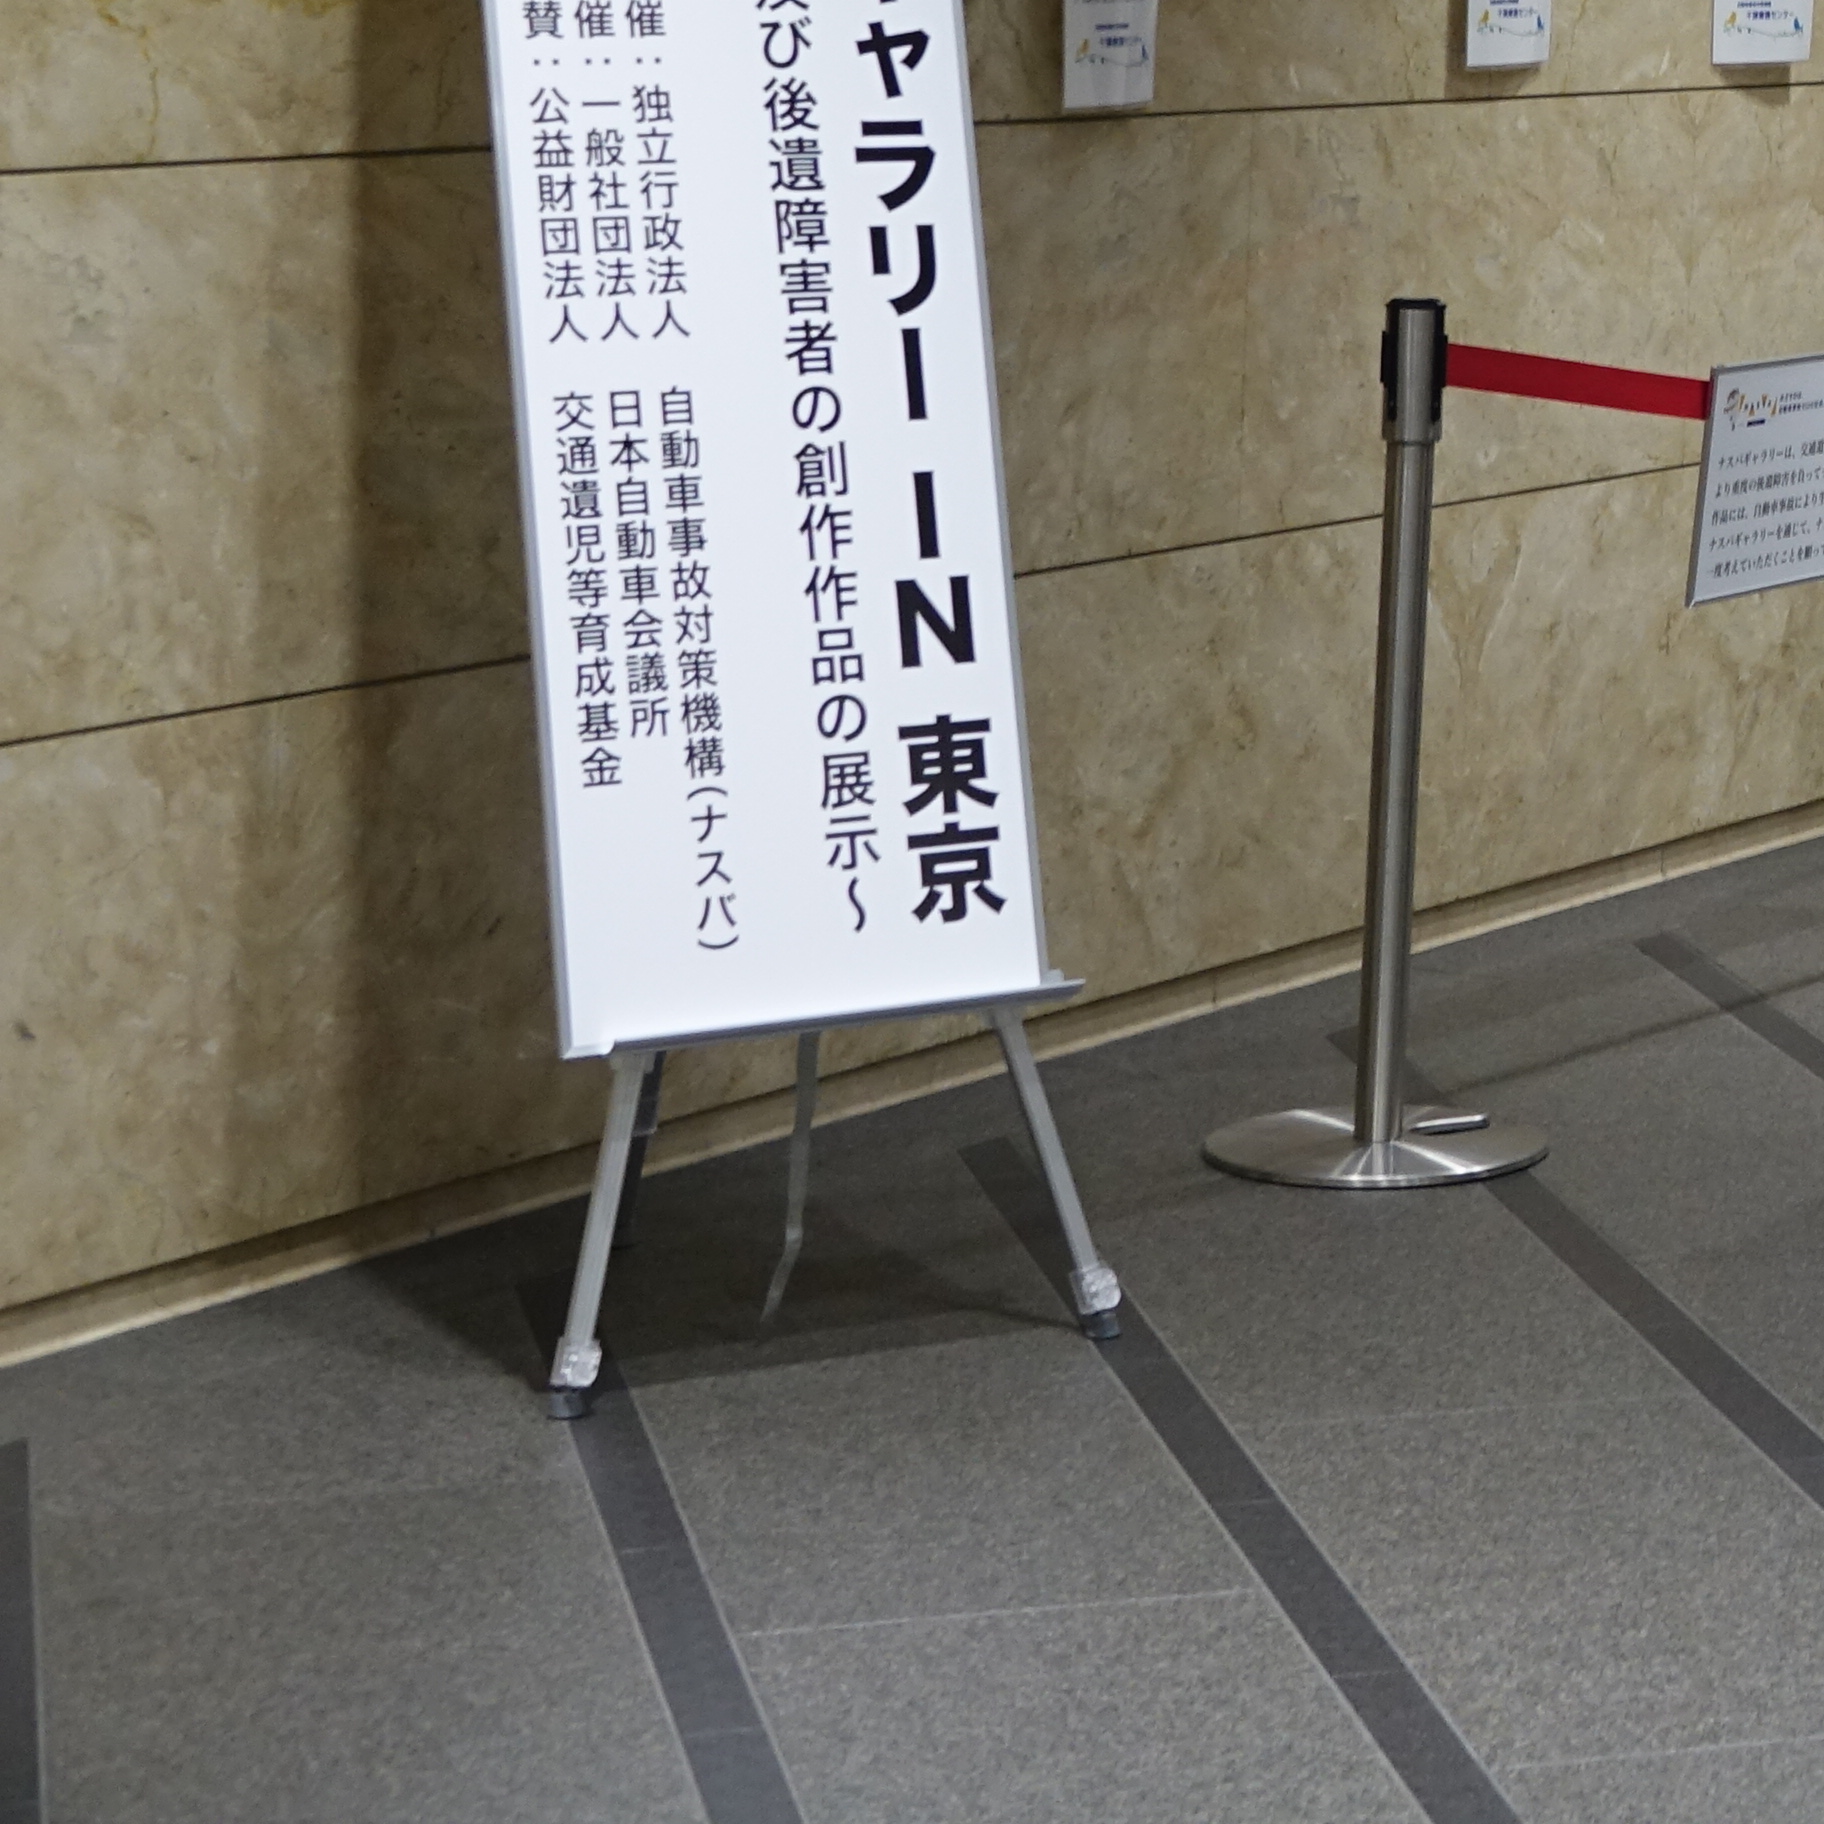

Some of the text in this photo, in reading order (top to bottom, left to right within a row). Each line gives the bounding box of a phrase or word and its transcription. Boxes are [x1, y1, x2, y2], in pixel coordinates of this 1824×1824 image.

[553, 391, 623, 789] 交通遺児等育成基金
[608, 389, 671, 738] 日本自動車会議所
[898, 713, 1007, 924] 東京
